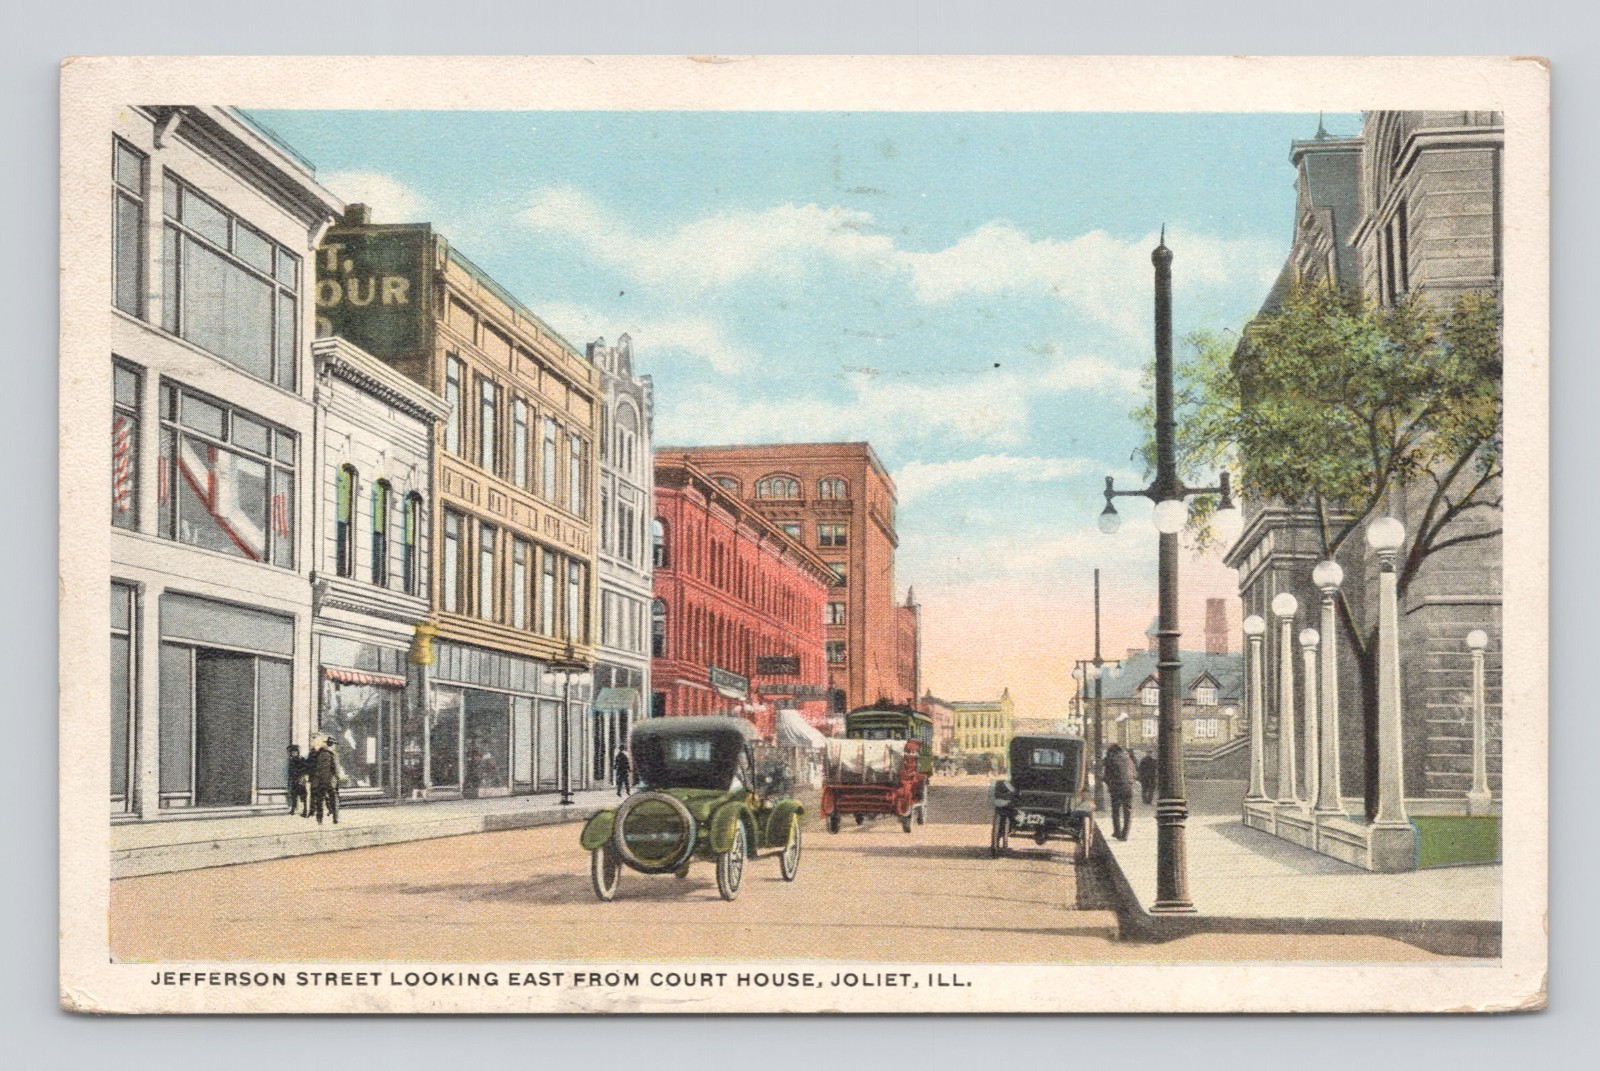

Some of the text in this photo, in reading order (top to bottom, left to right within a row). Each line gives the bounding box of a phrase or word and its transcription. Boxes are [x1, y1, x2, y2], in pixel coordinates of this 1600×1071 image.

[151, 971, 972, 989] JEFFERSON STREET LOOKING EAST FROM COURT HOUSE, JOLIET, ILL.
